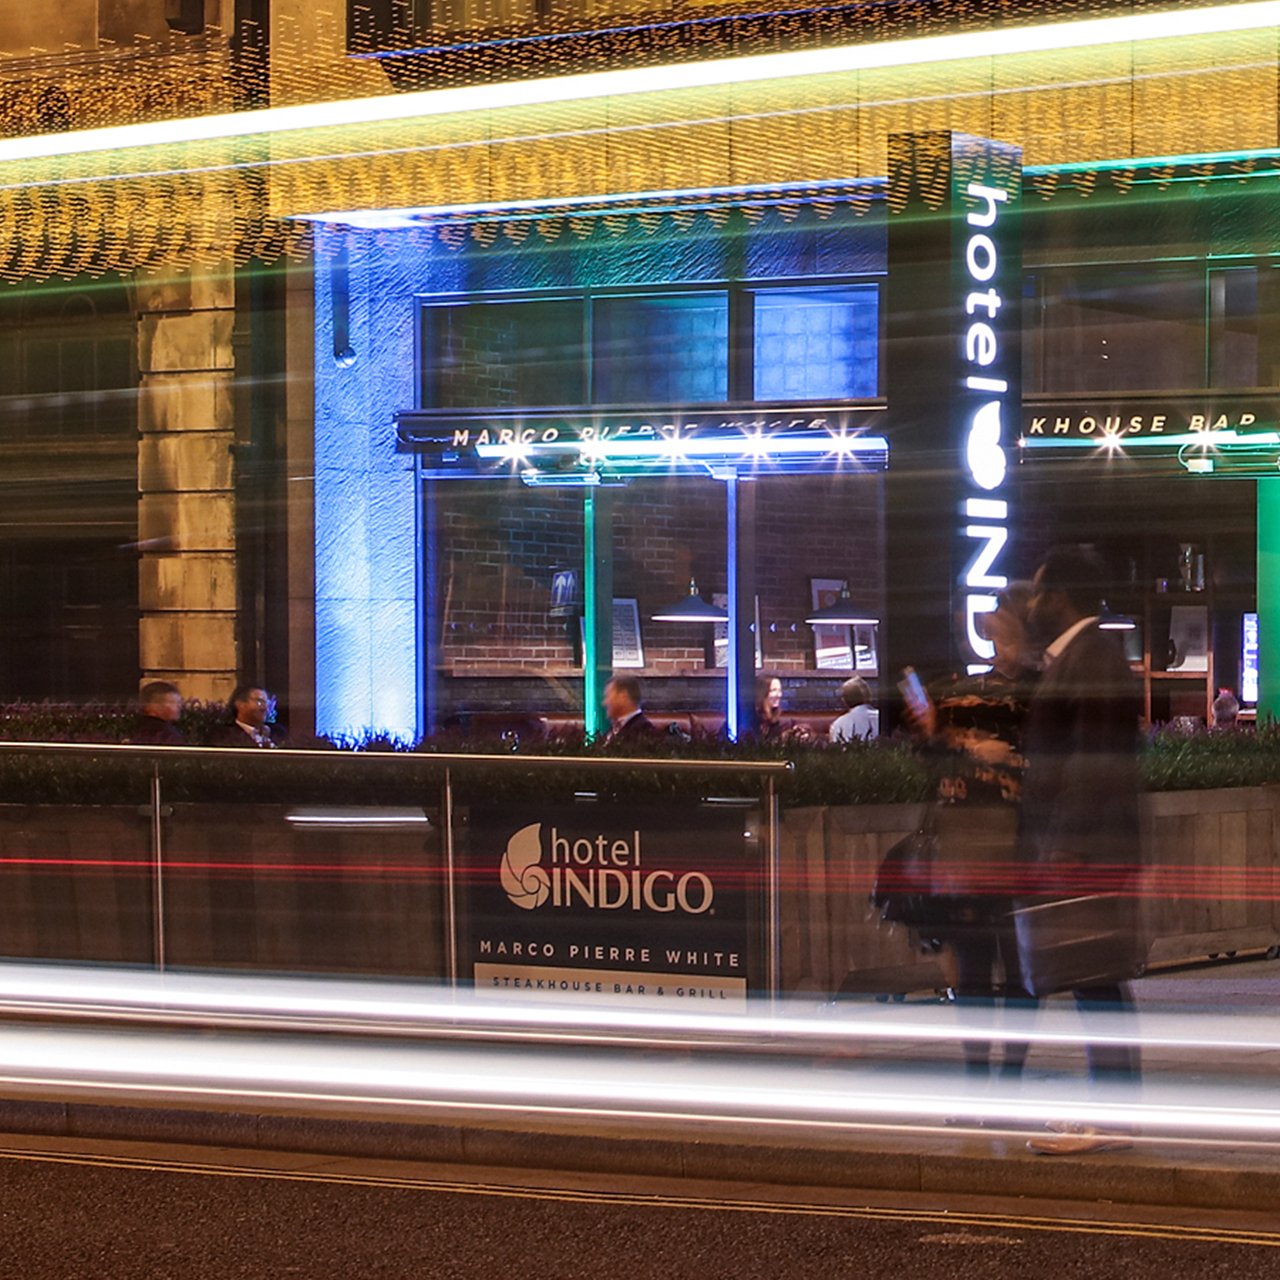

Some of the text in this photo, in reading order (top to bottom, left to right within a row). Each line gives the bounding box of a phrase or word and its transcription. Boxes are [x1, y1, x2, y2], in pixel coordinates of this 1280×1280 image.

[966, 183, 1008, 393] hotel
[452, 428, 559, 447] MARCO
[551, 827, 641, 867] hotel
[552, 867, 715, 915] INDIGO
[479, 940, 740, 967] MARCO PIERRE WHITE
[493, 976, 727, 1000] STEAKHOUSE BAR & GRILL
